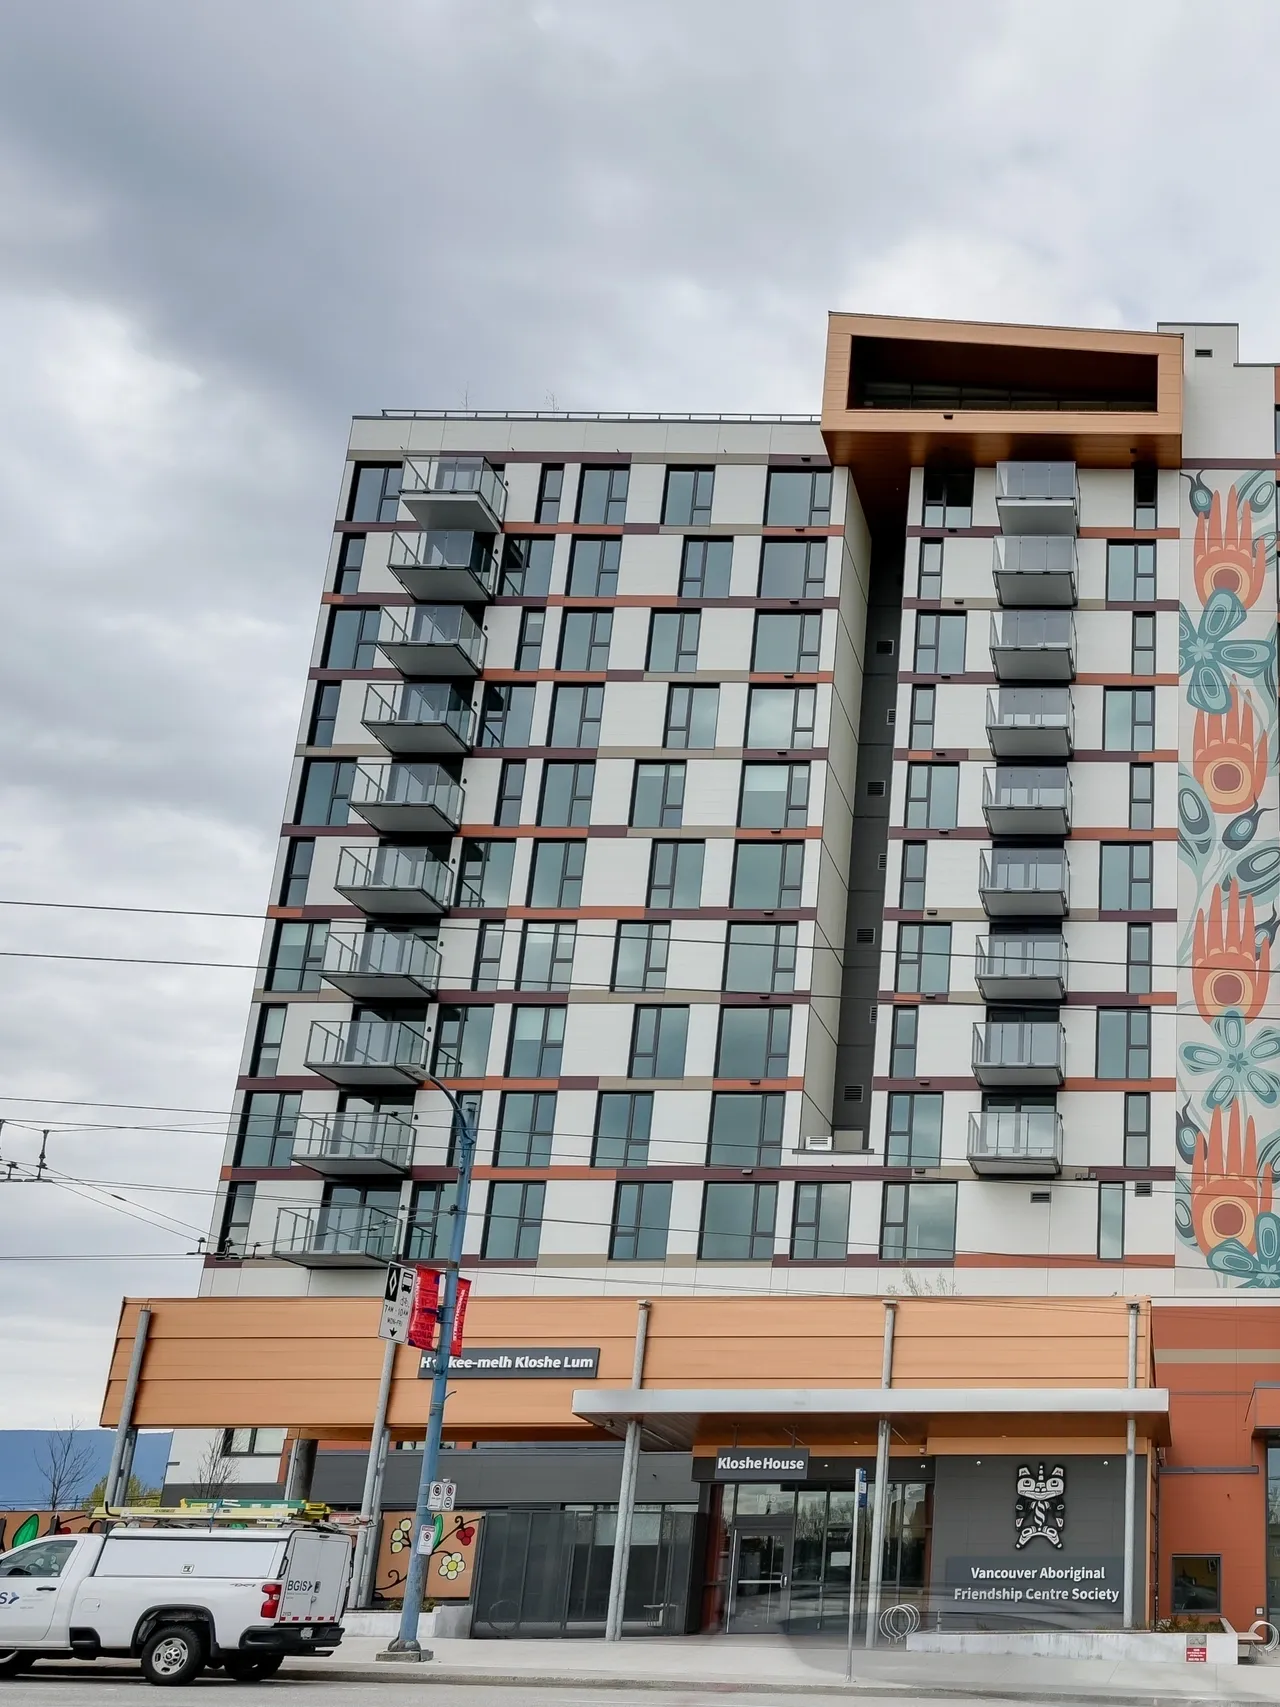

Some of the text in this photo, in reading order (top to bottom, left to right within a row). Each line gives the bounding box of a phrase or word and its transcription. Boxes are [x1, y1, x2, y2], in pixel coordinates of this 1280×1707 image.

[515, 1356, 561, 1369] Kloshe
[564, 1356, 593, 1369] Lum
[717, 1456, 805, 1470] Kloshe House
[970, 1566, 1106, 1582] Vancouver Aboriginal
[287, 1580, 308, 1592] BGIS
[954, 1587, 1120, 1603] Friendship Centre Society
